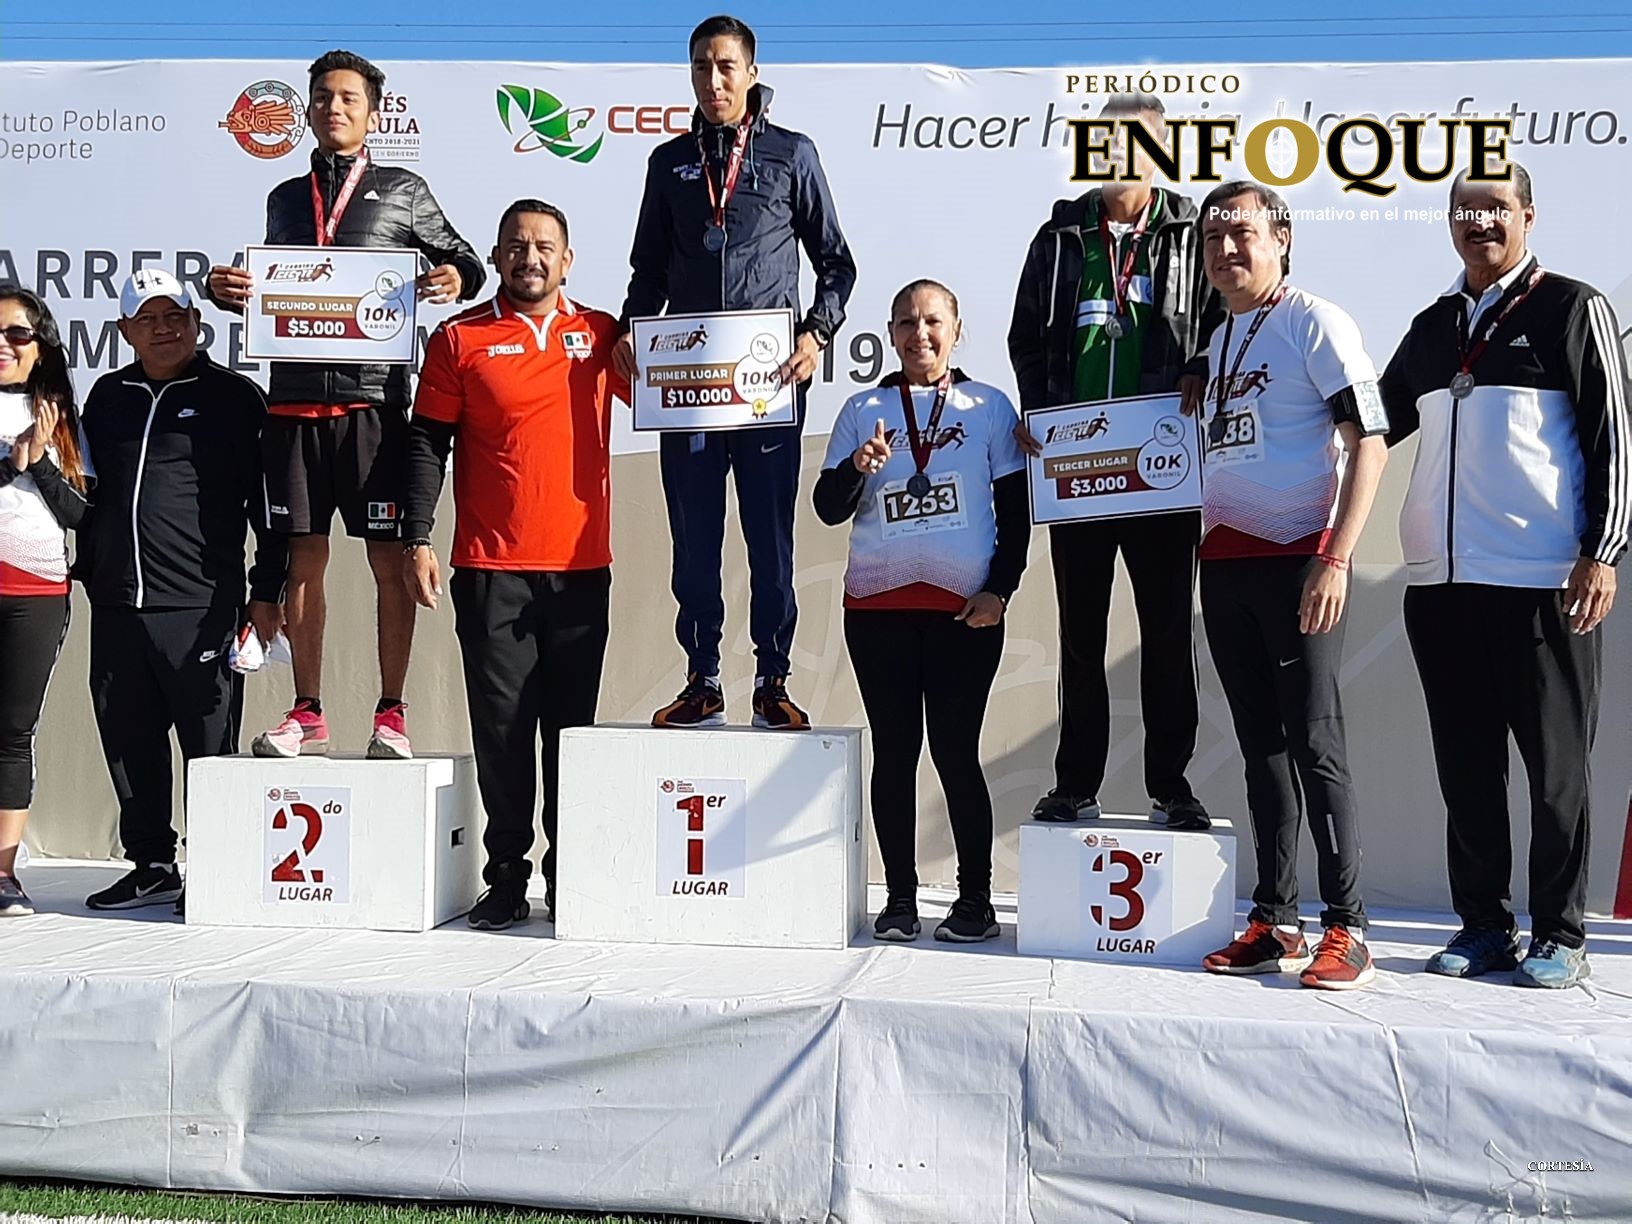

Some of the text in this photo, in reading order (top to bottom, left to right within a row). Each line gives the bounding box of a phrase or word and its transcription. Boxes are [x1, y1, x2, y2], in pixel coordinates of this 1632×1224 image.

[382, 92, 408, 113] ÉS
[63, 109, 167, 132] Poblano
[872, 103, 1031, 149] Hacer
[0, 138, 94, 165] Deporte
[267, 301, 353, 312] SEGUNDO LUGAR
[364, 307, 398, 322] 10K
[288, 317, 346, 337] $5,000
[650, 368, 728, 381] PRIMER LUGAR
[667, 387, 733, 407] $10,000
[1053, 456, 1128, 472] TERCER LUGAR
[1145, 453, 1182, 471] 10K
[1070, 475, 1128, 497] $3,000
[886, 486, 956, 519] 1253
[279, 887, 334, 902] LUGAR
[672, 881, 729, 896] LUGAR
[1096, 938, 1156, 954] LUGAR
